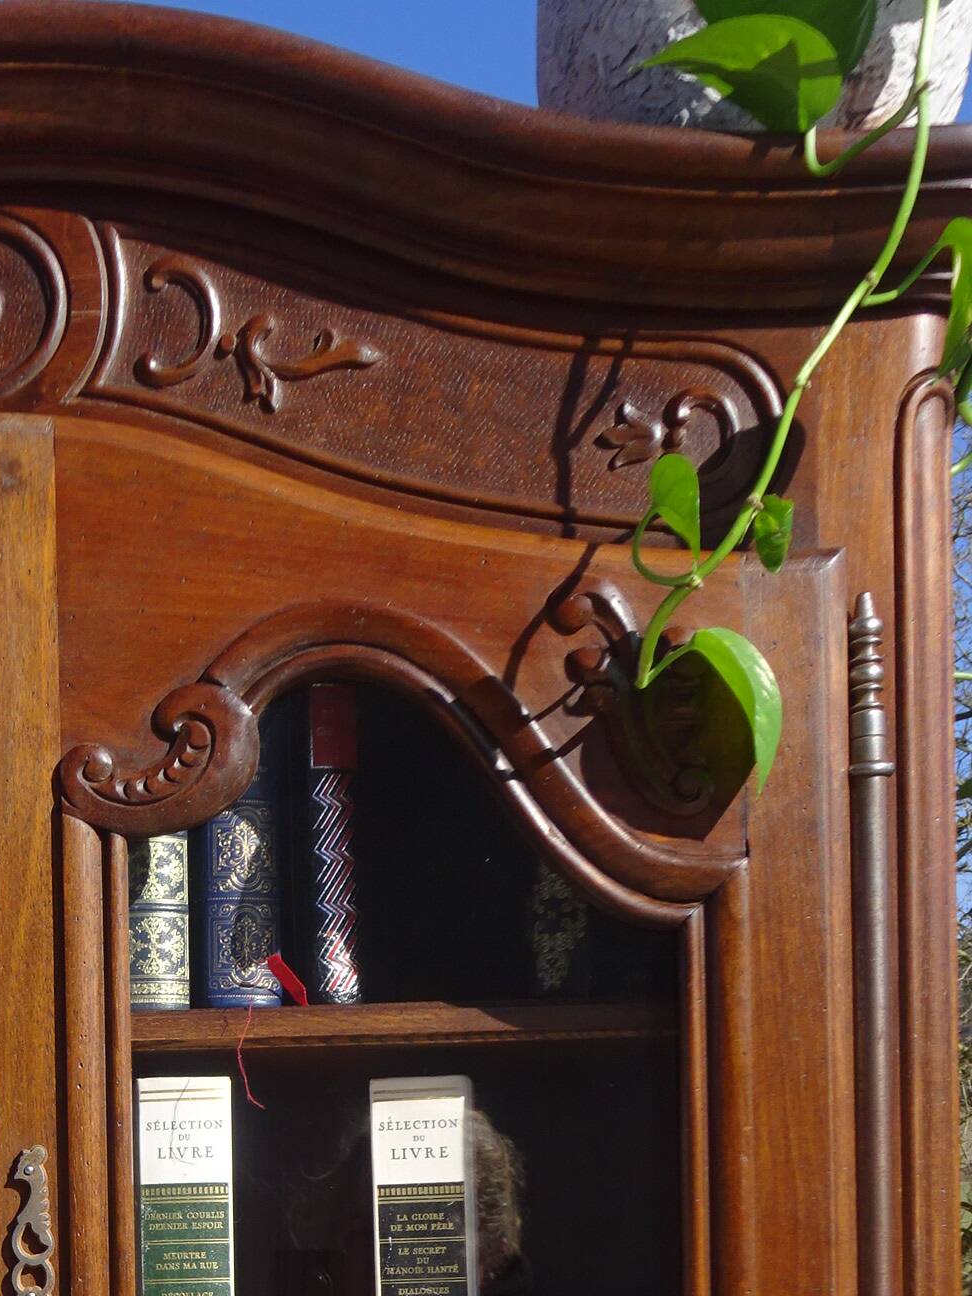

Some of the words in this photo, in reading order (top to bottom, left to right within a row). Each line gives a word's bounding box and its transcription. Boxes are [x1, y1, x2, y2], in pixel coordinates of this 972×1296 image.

[146, 1119, 223, 1131] SÉLECTION
[378, 1117, 458, 1131] SÉLECTION
[157, 1146, 214, 1160] LIVRE
[391, 1146, 449, 1160] LIVRE
[187, 1211, 225, 1219] COURLIS
[396, 1213, 408, 1222] LA
[412, 1212, 445, 1221] GLOIRE
[149, 1222, 188, 1231] DERNIER
[192, 1221, 224, 1230] ESPOIR
[390, 1224, 402, 1232] DE
[406, 1223, 428, 1231] MON
[398, 1247, 410, 1255] LE
[413, 1246, 447, 1255] SECRET
[163, 1252, 207, 1260] MEURTRE
[417, 1257, 430, 1265] DU
[156, 1263, 181, 1271] DANS
[183, 1262, 197, 1270] MA
[200, 1262, 219, 1270] RUE
[387, 1266, 424, 1275] MANOIR
[428, 1264, 459, 1274] HANTÉ
[398, 1286, 450, 1296] DIALOGUES
